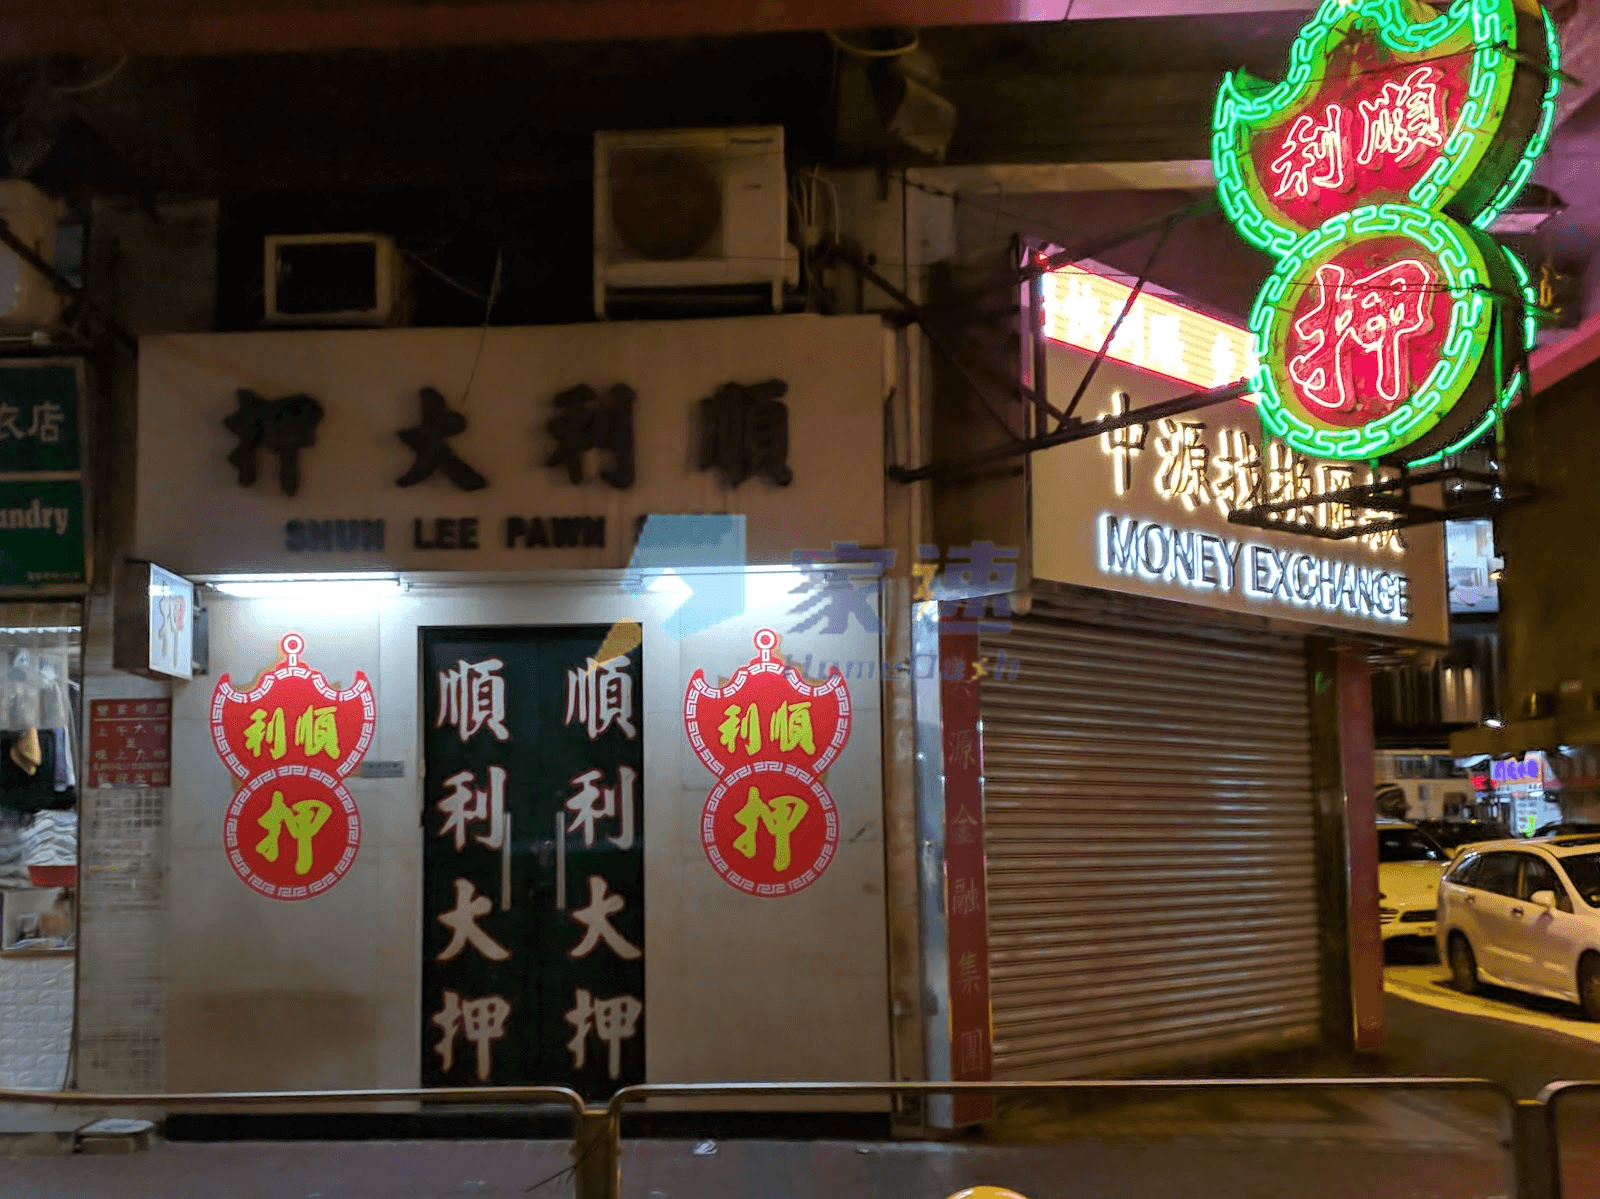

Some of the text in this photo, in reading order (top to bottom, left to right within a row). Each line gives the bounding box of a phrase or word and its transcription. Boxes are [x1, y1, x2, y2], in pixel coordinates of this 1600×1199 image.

[1288, 258, 1432, 410] 押
[284, 517, 386, 552] SHUN
[414, 517, 479, 550] LEE
[506, 516, 606, 550] PAWN
[1099, 514, 1413, 621] MONEY EXCHANGE
[255, 790, 332, 875] 押
[433, 657, 511, 1081] 順利大押
[565, 655, 643, 1081] 順利大押
[733, 786, 809, 872] 押
